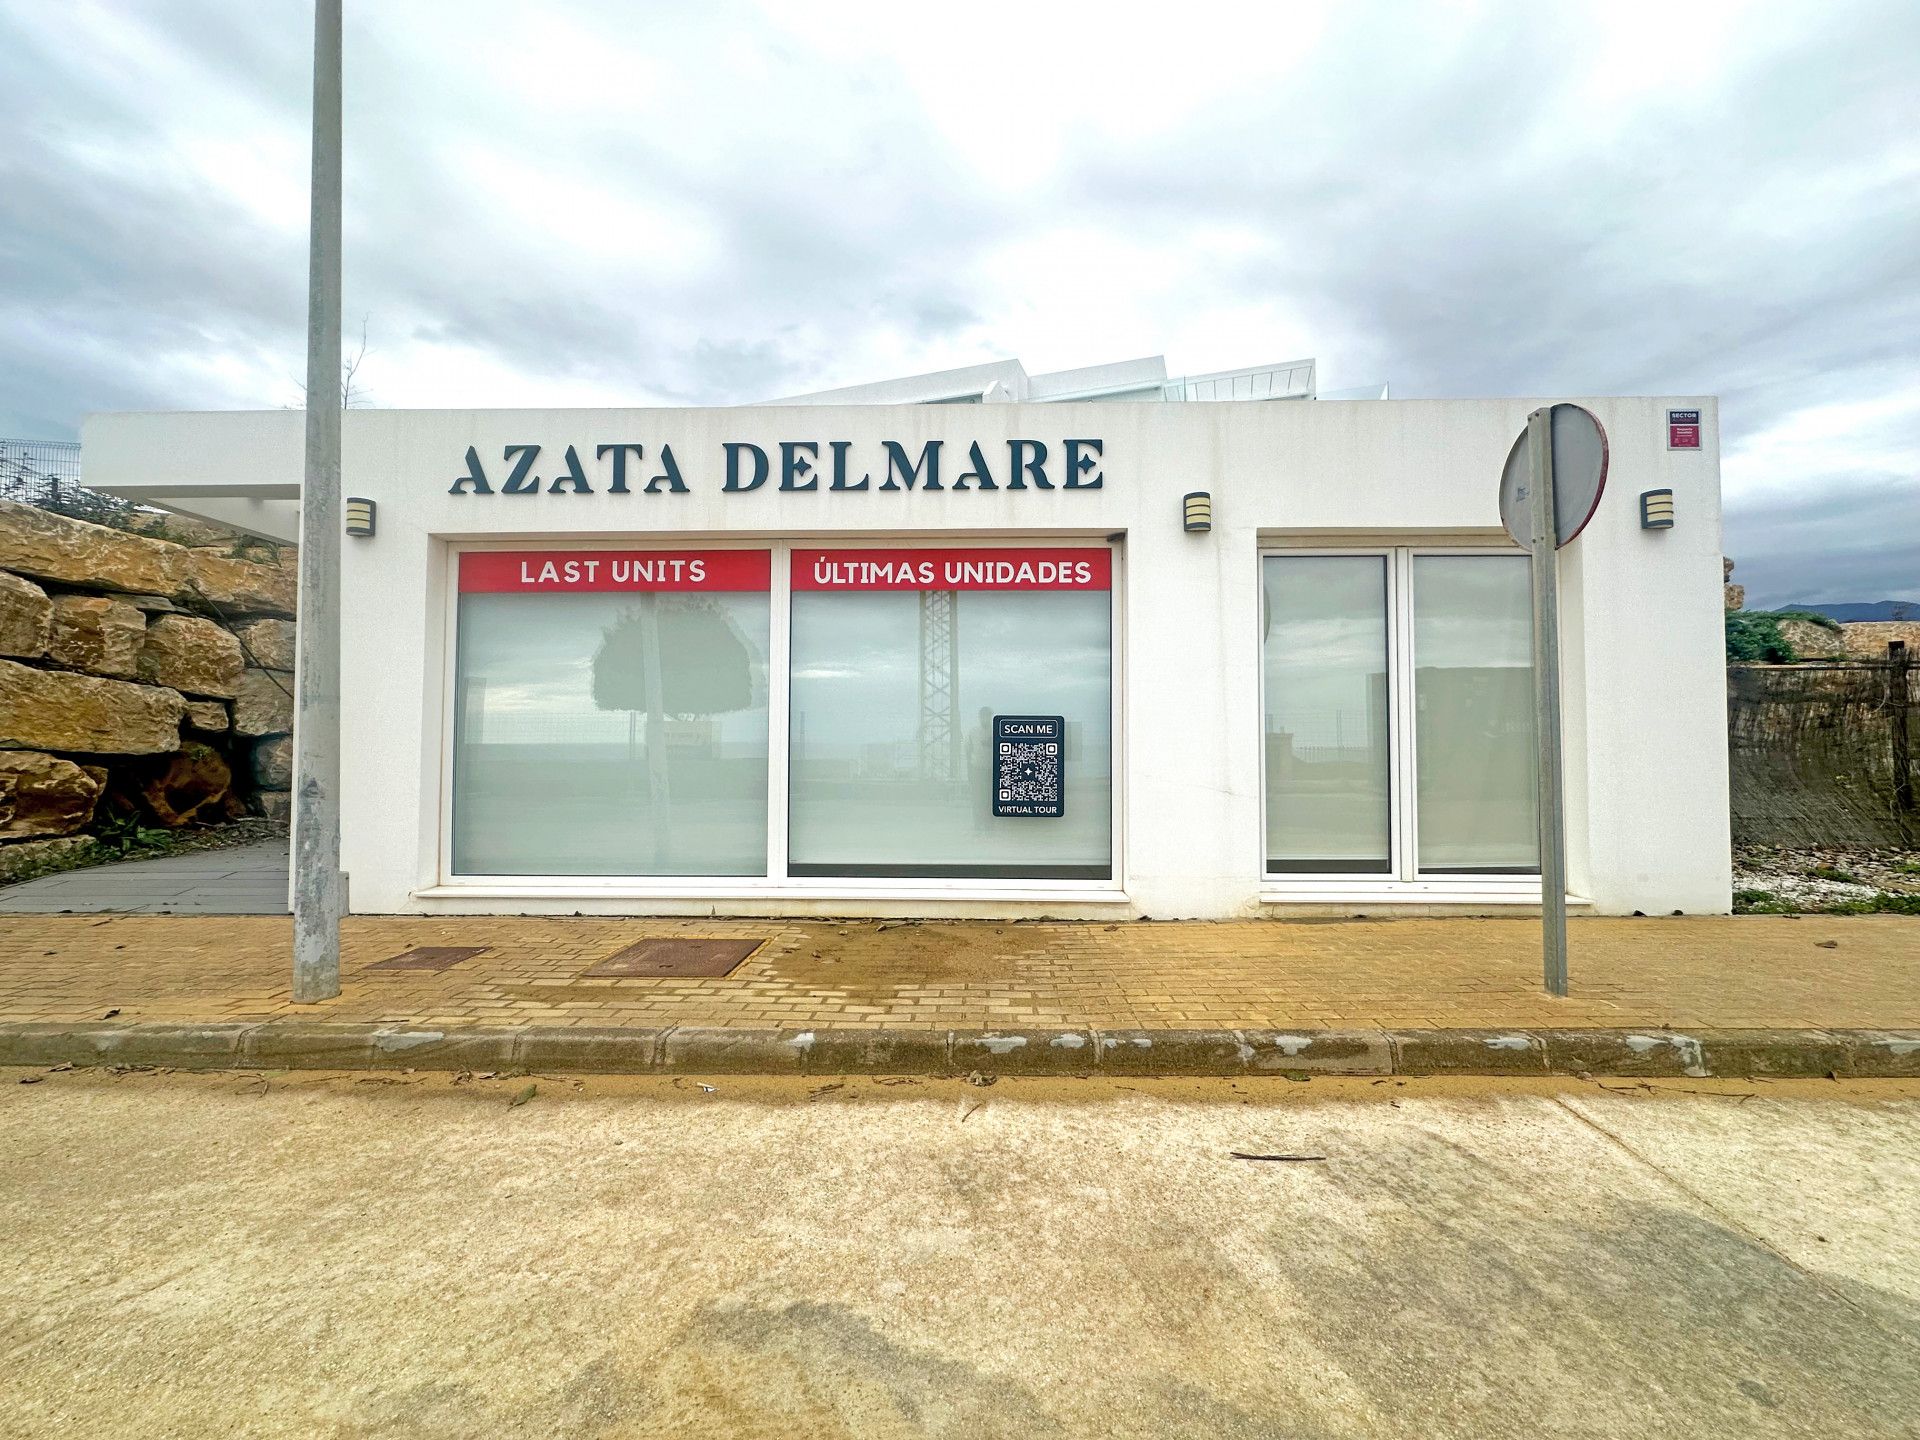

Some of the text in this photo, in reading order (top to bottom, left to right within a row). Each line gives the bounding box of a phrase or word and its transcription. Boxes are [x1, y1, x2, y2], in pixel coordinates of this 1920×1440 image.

[447, 438, 1104, 495] AZATA DELMARE
[520, 559, 706, 583] LAST UNITS
[813, 556, 1092, 585] ÚLTIMAS UNIDADES
[1004, 724, 1053, 734] SCAN ME
[998, 805, 1057, 814] VIRTUAL TOUR
